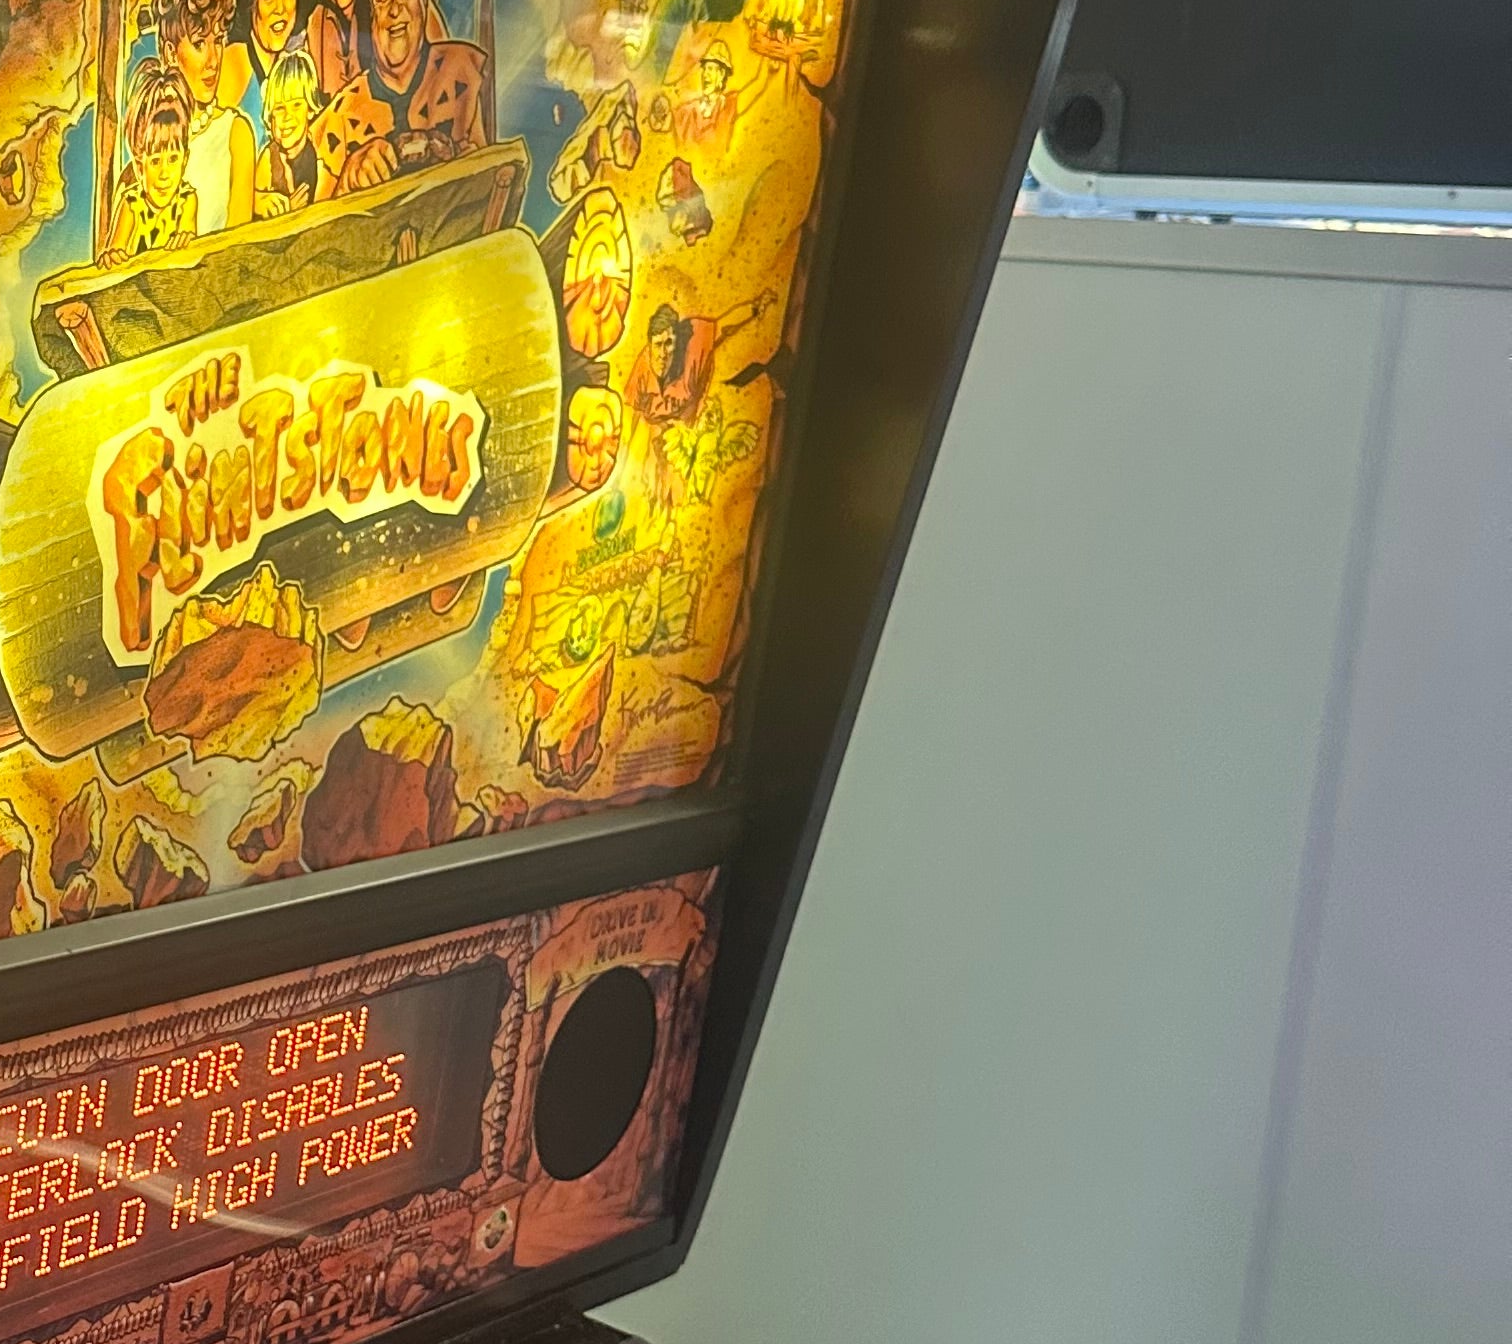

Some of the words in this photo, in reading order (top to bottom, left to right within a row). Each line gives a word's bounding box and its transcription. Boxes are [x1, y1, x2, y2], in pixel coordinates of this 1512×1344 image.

[164, 351, 242, 437] THE
[102, 371, 475, 652] FLINTSTONES
[590, 903, 638, 939] DRIVE
[594, 927, 646, 965] MOVIE
[132, 1041, 244, 1117] DOOR
[267, 1005, 370, 1076] OPEN
[205, 1053, 407, 1158] DISABLES
[170, 1152, 279, 1230] HIGH
[298, 1106, 420, 1187] POWER
